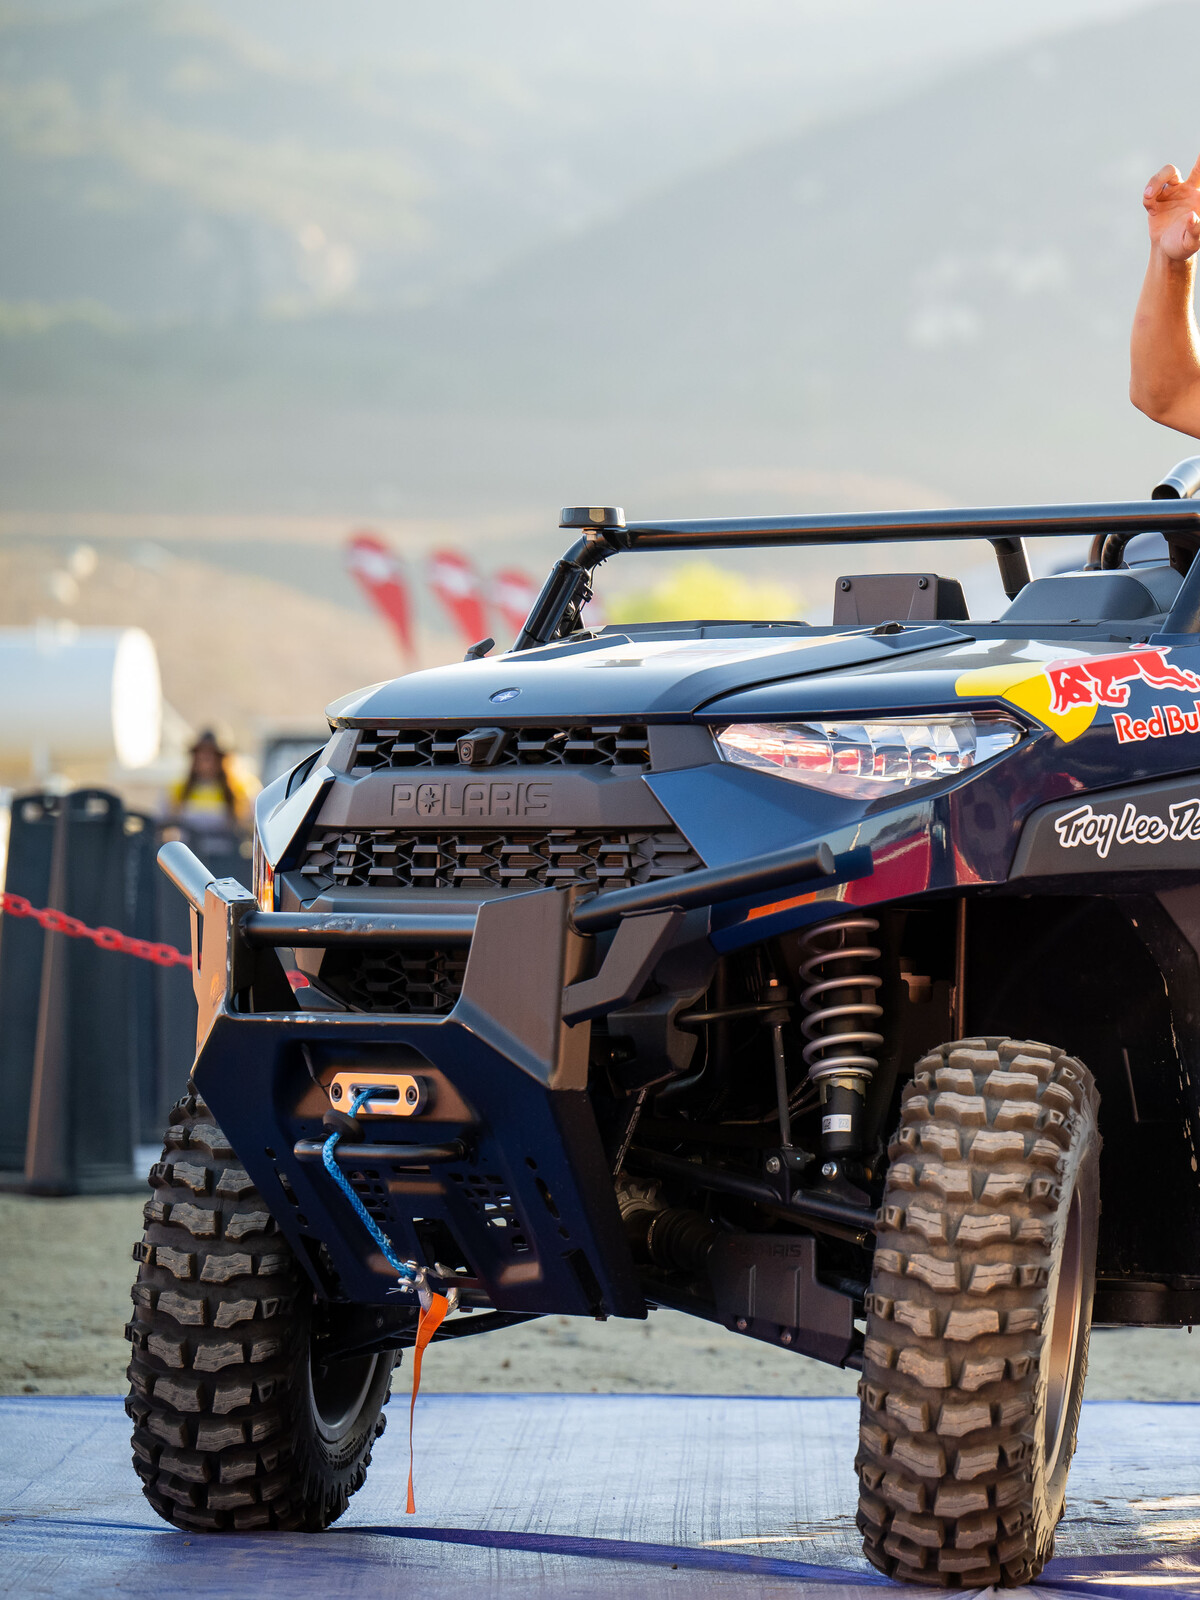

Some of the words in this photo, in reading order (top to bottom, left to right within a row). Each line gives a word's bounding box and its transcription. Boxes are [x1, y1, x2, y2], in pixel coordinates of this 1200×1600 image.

[1112, 705, 1166, 744] Red
[391, 782, 554, 817] POLARIS
[1055, 804, 1117, 858] Troy
[1116, 803, 1168, 844] Lee
